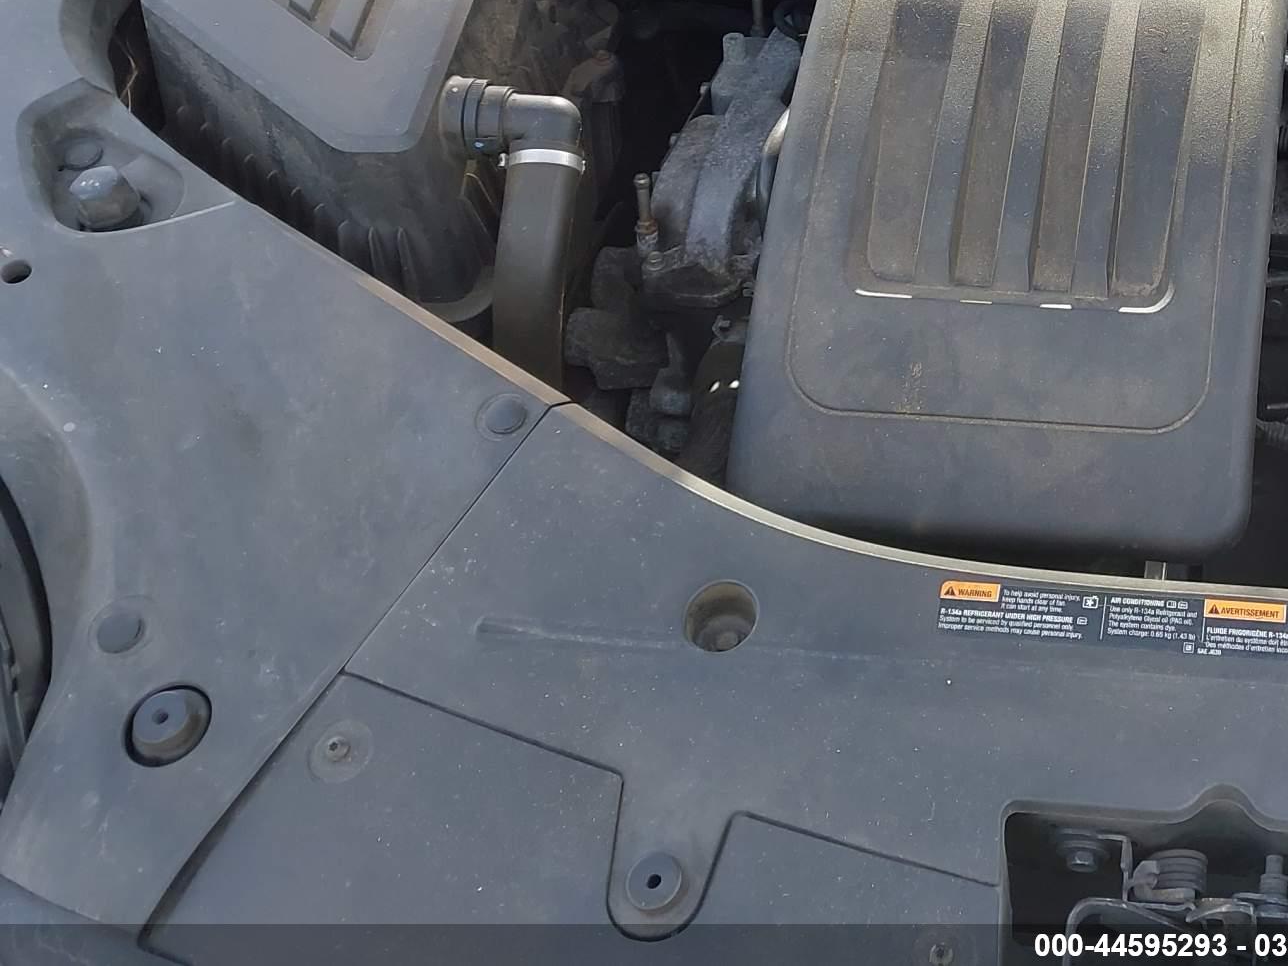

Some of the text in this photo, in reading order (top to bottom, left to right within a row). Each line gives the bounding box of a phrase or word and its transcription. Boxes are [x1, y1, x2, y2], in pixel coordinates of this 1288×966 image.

[958, 589, 992, 597] WARNING
[1123, 598, 1164, 606] CONDITIONING
[963, 610, 1004, 618] REFRIGERANT
[1221, 607, 1279, 618] AVERTISSEMENT
[938, 622, 964, 630] Improper
